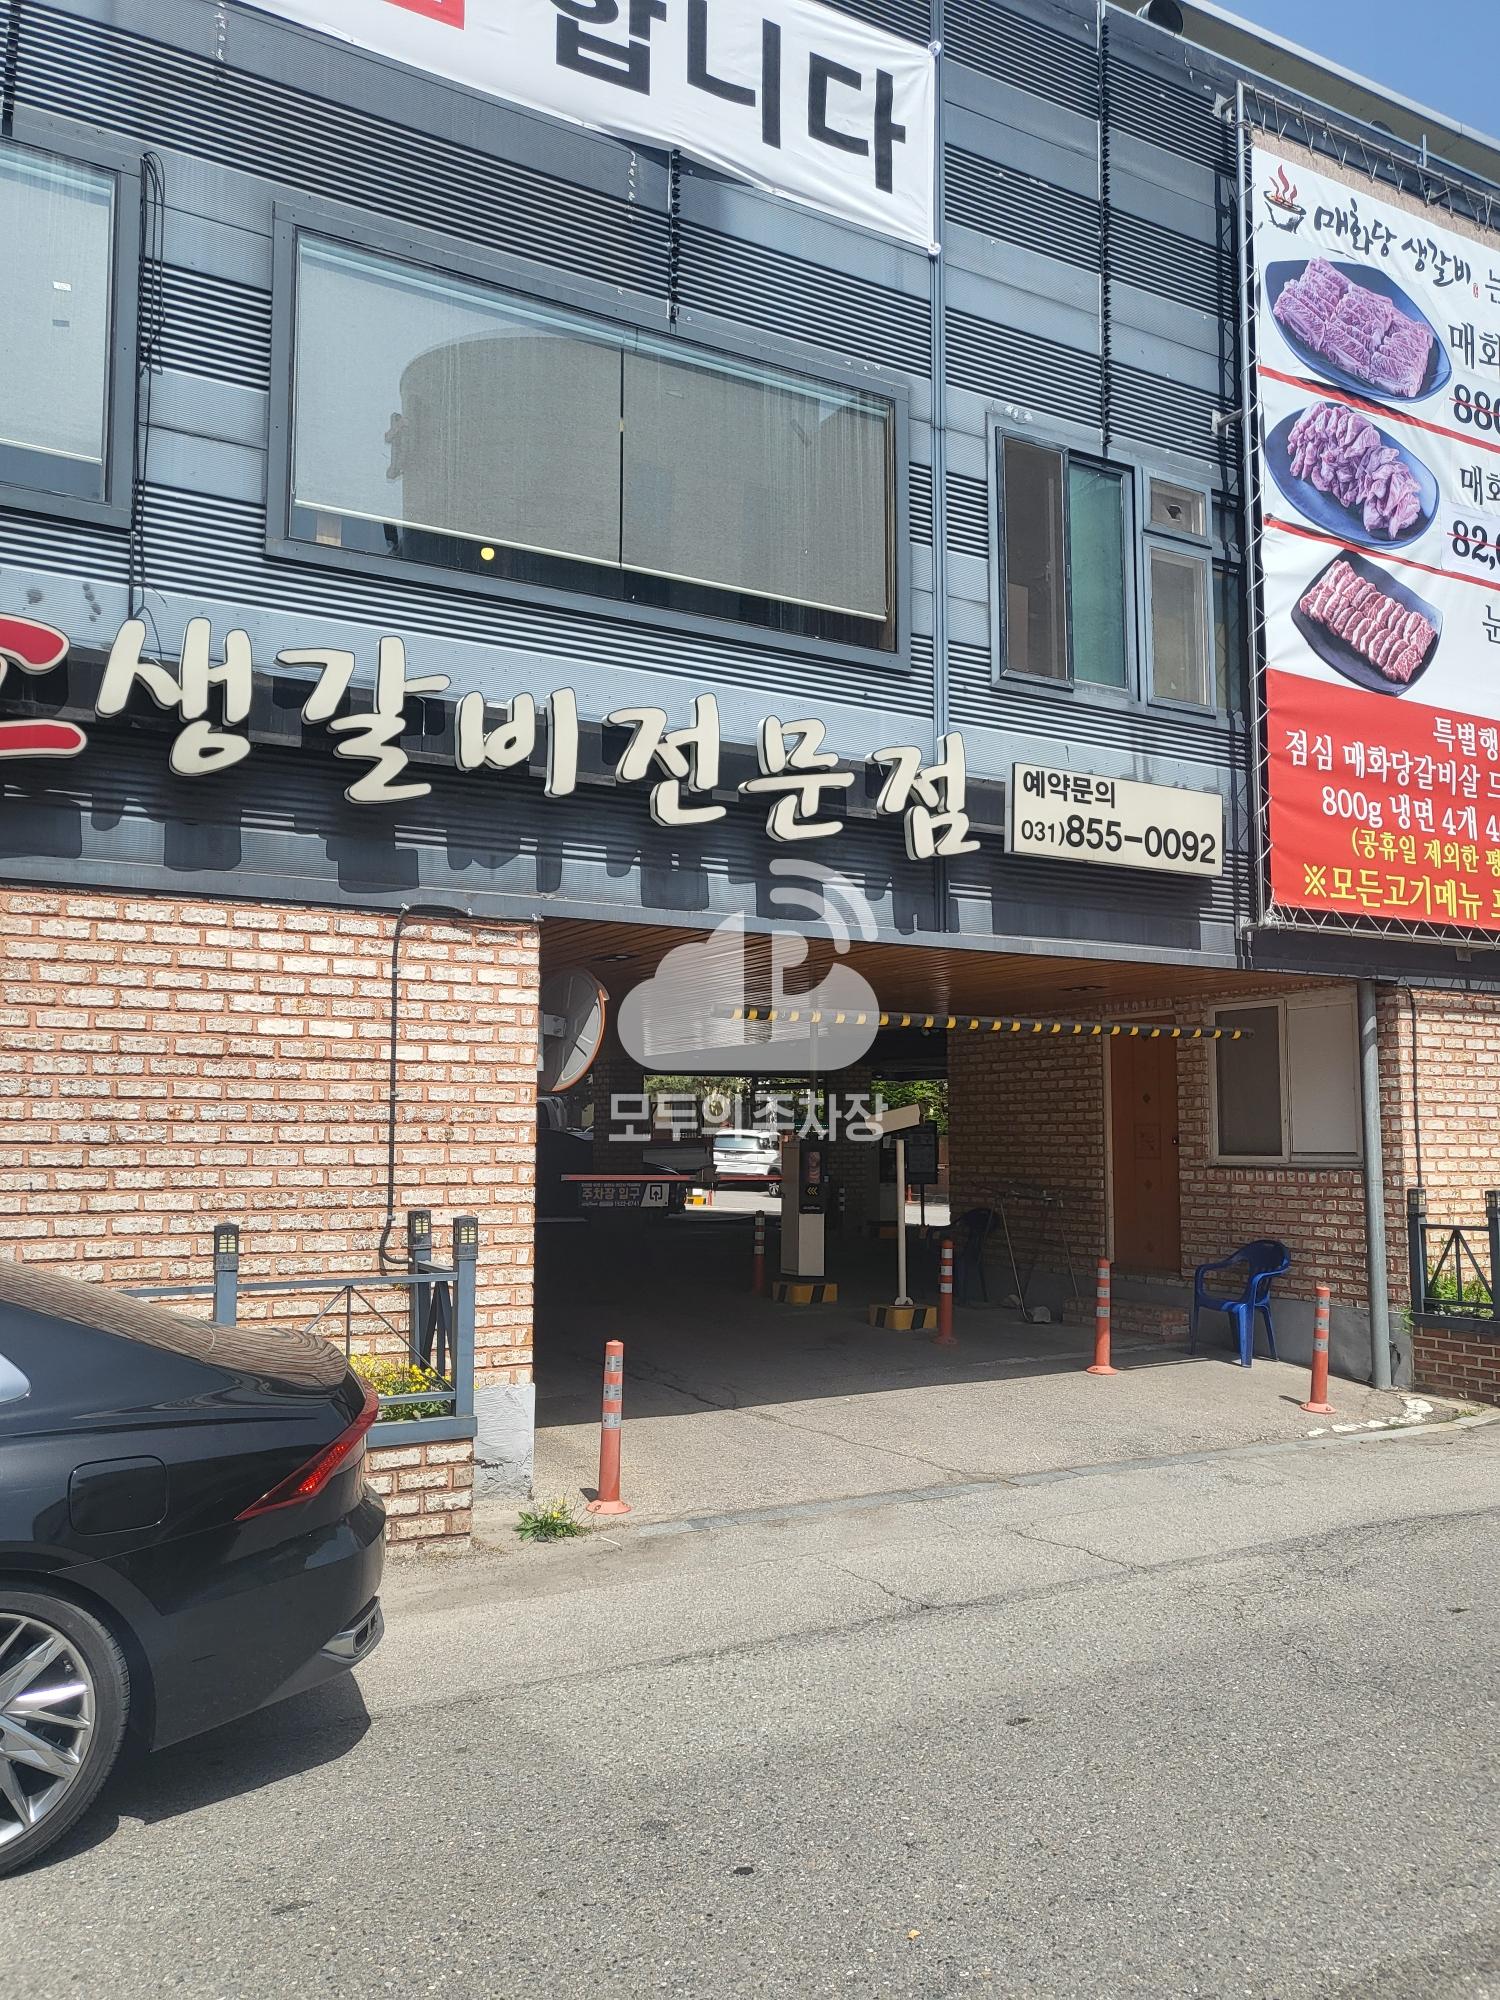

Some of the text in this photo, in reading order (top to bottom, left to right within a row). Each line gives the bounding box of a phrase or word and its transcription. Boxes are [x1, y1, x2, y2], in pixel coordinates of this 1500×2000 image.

[1314, 198, 1397, 257] 매화당
[1401, 238, 1471, 287] 생갈비
[1453, 384, 1500, 435] 88
[1452, 519, 1500, 570] 82,
[96, 617, 980, 860] 생갈비전문점
[1285, 729, 1333, 771] 점심
[1342, 741, 1480, 798] 매화당갈비살
[1433, 717, 1499, 761] 특별행
[1023, 770, 1115, 809] 예약문의
[1322, 786, 1383, 828] 800g
[1389, 794, 1435, 832] 냉면
[1442, 806, 1477, 841] 4개
[1021, 814, 1216, 865] 031)855-0092
[1352, 827, 1417, 864] (공휴일
[1423, 839, 1479, 873] 제외한
[582, 1187, 640, 1200] 주차장 입구
